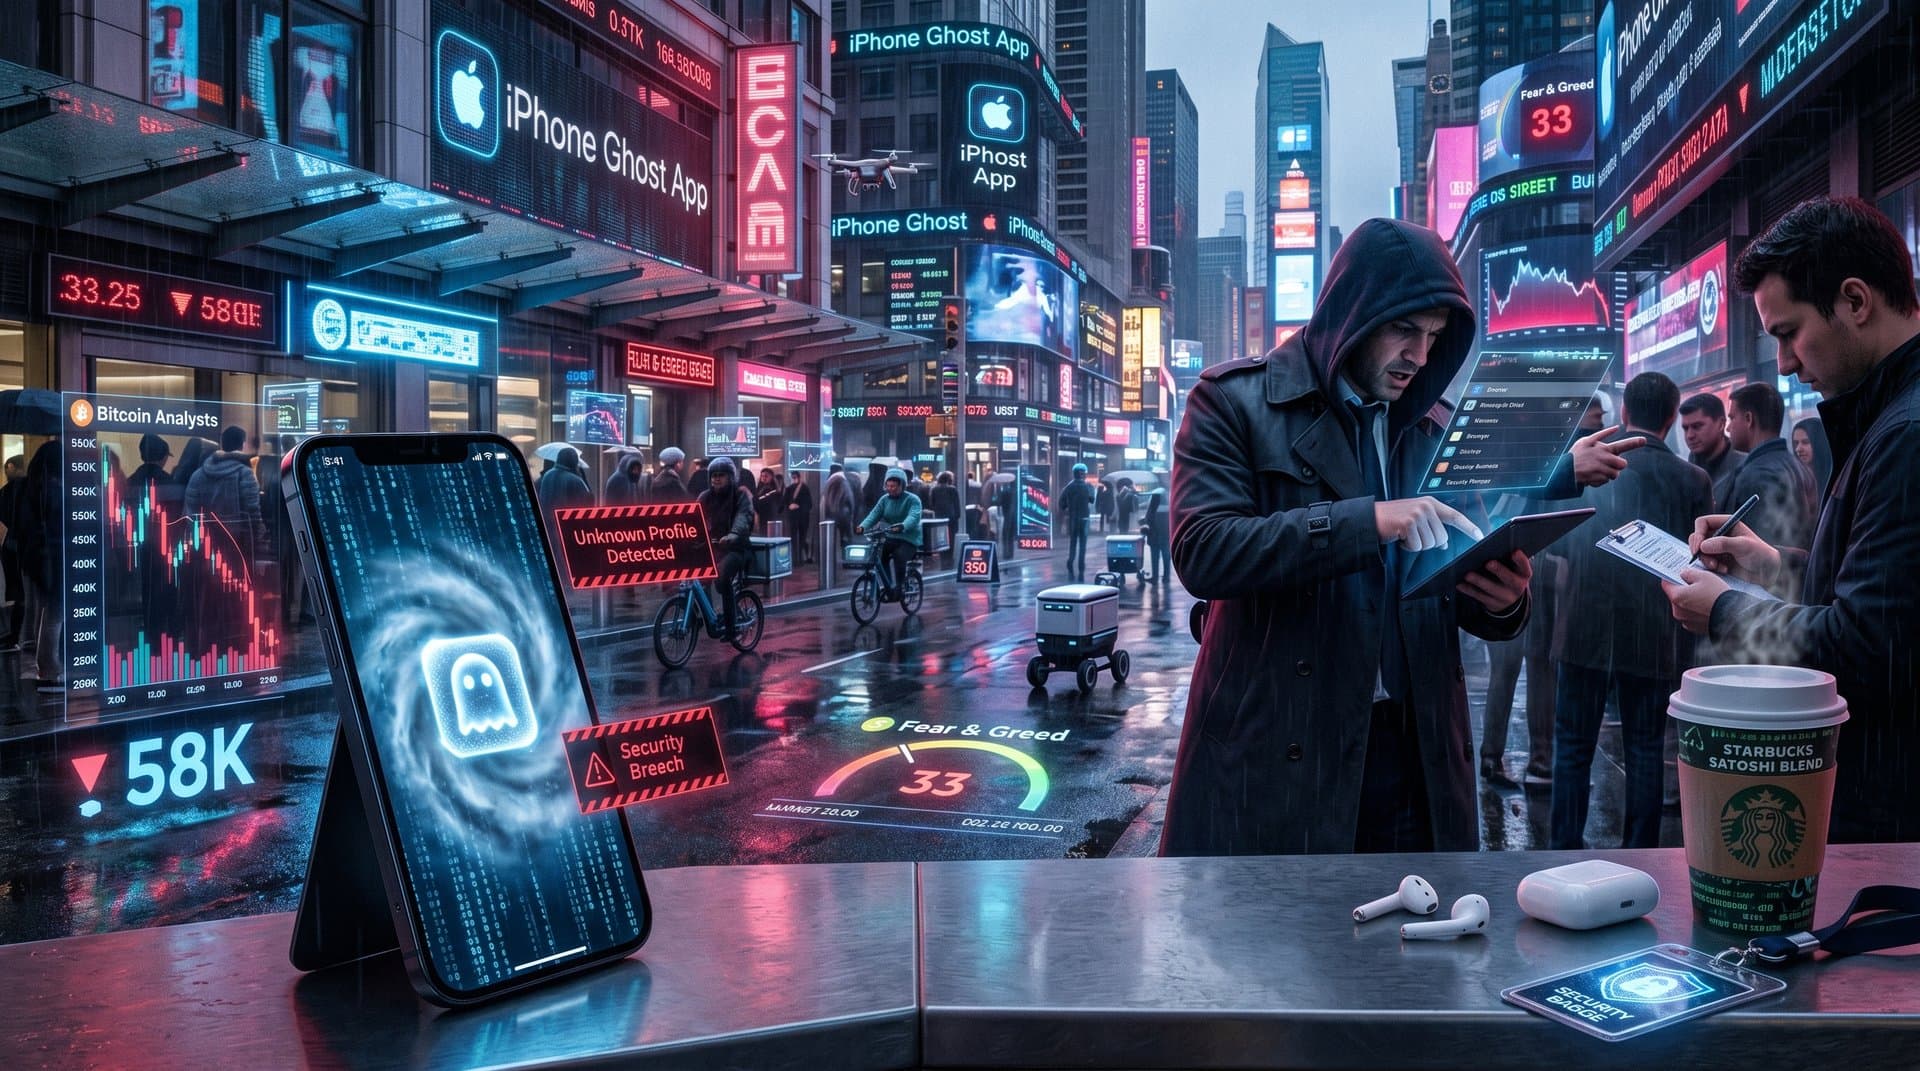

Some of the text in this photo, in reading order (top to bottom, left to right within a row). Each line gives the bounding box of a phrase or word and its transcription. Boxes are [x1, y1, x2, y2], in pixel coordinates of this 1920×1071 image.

[850, 26, 1029, 60] iPhone Ghost App
[1521, 79, 1594, 101] Fear & Greed
[1531, 104, 1573, 138] 33
[505, 83, 708, 216] iPhone Ghost App
[960, 145, 1027, 169] iPhost
[973, 167, 1017, 191] App
[832, 217, 900, 237] iPhone
[905, 212, 968, 231] Ghost
[97, 405, 218, 430] Bitcoin Analysts
[71, 534, 97, 545] 450K
[574, 523, 698, 546] Unknown Profile
[72, 558, 97, 569] 400K
[606, 544, 675, 565] Detected
[964, 562, 987, 574] 350
[72, 582, 97, 593] 400K
[73, 631, 97, 642] 320K
[898, 720, 1071, 742] Fear & Greed
[620, 734, 684, 760] Security
[1723, 744, 1814, 758] STARBUCKS
[127, 723, 255, 807] 58K
[630, 756, 685, 780] Breech
[1708, 757, 1823, 773] SATOSHI BLEND
[899, 769, 972, 798] 33
[1554, 986, 1635, 1020] SECURITY
